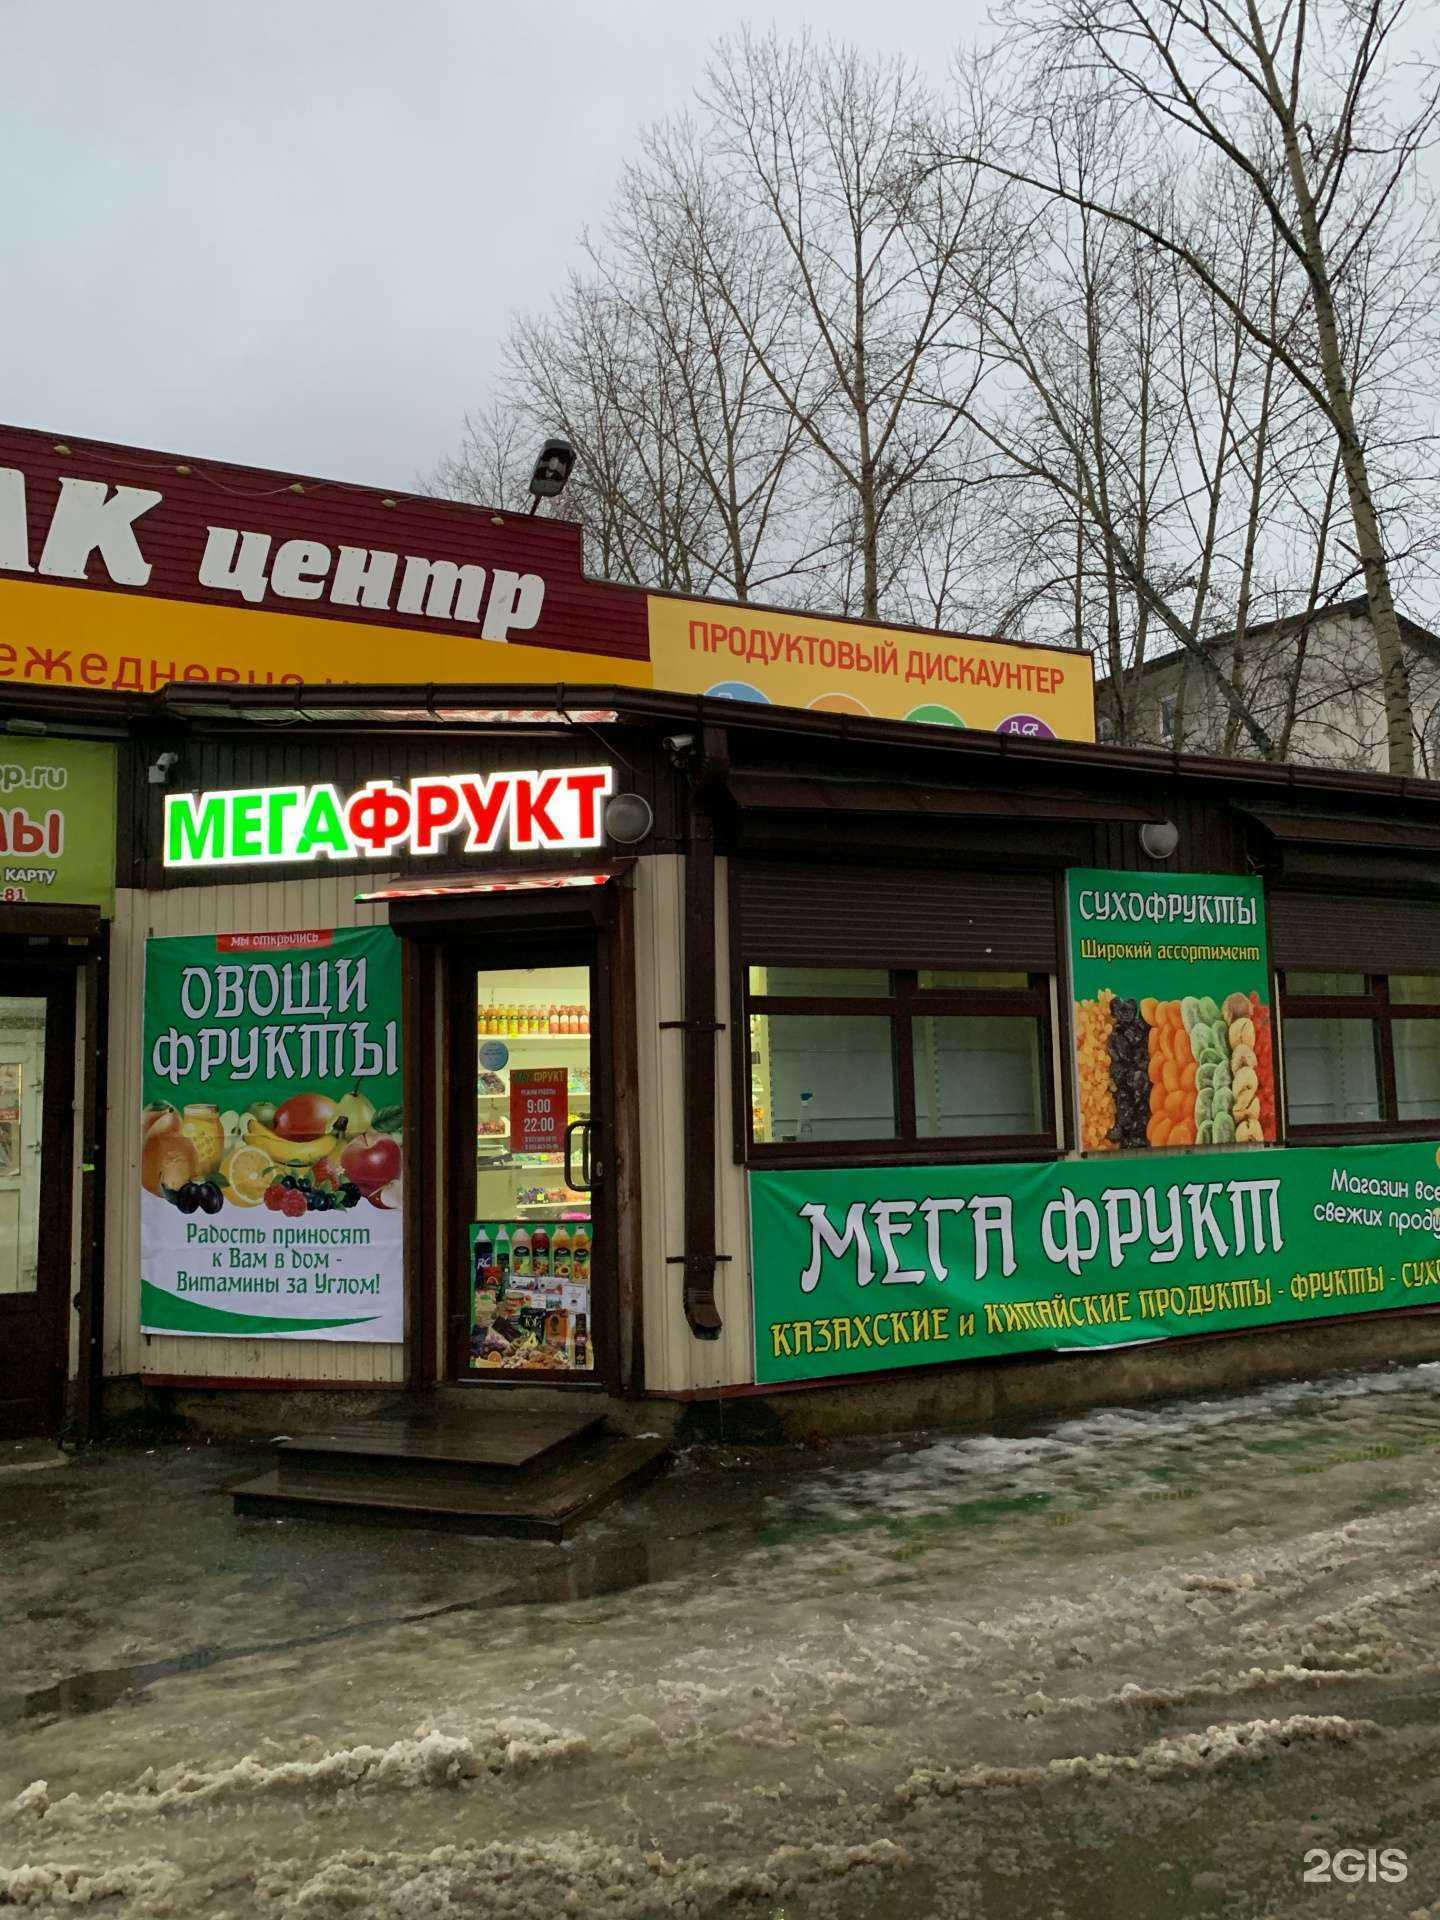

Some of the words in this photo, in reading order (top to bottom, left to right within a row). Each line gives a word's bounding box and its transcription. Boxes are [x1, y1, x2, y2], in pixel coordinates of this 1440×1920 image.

[199, 525, 546, 644] центр
[688, 620, 899, 676] ПРОДУКТОВЫЙ
[904, 650, 1066, 695] ДИСКАУНТЕР
[0, 765, 66, 792] p.ru
[166, 770, 609, 864] МЕГАФРУКТ
[5, 867, 56, 885] КАРТУ
[1079, 890, 1257, 925] СУХОФРУКТЫ
[1081, 938, 1152, 962] Широкий
[1157, 943, 1260, 964] ассортимент
[181, 956, 369, 1021] ОВОЩИ
[152, 1019, 400, 1086] ФРУКТЫ
[527, 1098, 551, 1114] 9:00
[523, 1116, 555, 1132] 22:00
[1331, 1168, 1409, 1199] Магазин
[1314, 1201, 1383, 1227] свежих
[186, 1222, 266, 1244] Радость
[272, 1227, 370, 1249] приносят
[799, 1194, 1018, 1293] МЕГА
[1041, 1178, 1284, 1276] ФРУКТ
[229, 1247, 267, 1269] Вам
[177, 1271, 279, 1293] Витамины
[286, 1276, 307, 1294] за
[315, 1273, 381, 1295] Углом!
[770, 1307, 949, 1357] КАЗАХСКИЕ
[984, 1290, 1133, 1335] КИТАЙСКИЕ
[1139, 1277, 1272, 1320] ПРОДУКТЫ
[1290, 1265, 1385, 1302] ФРУКТЫ
